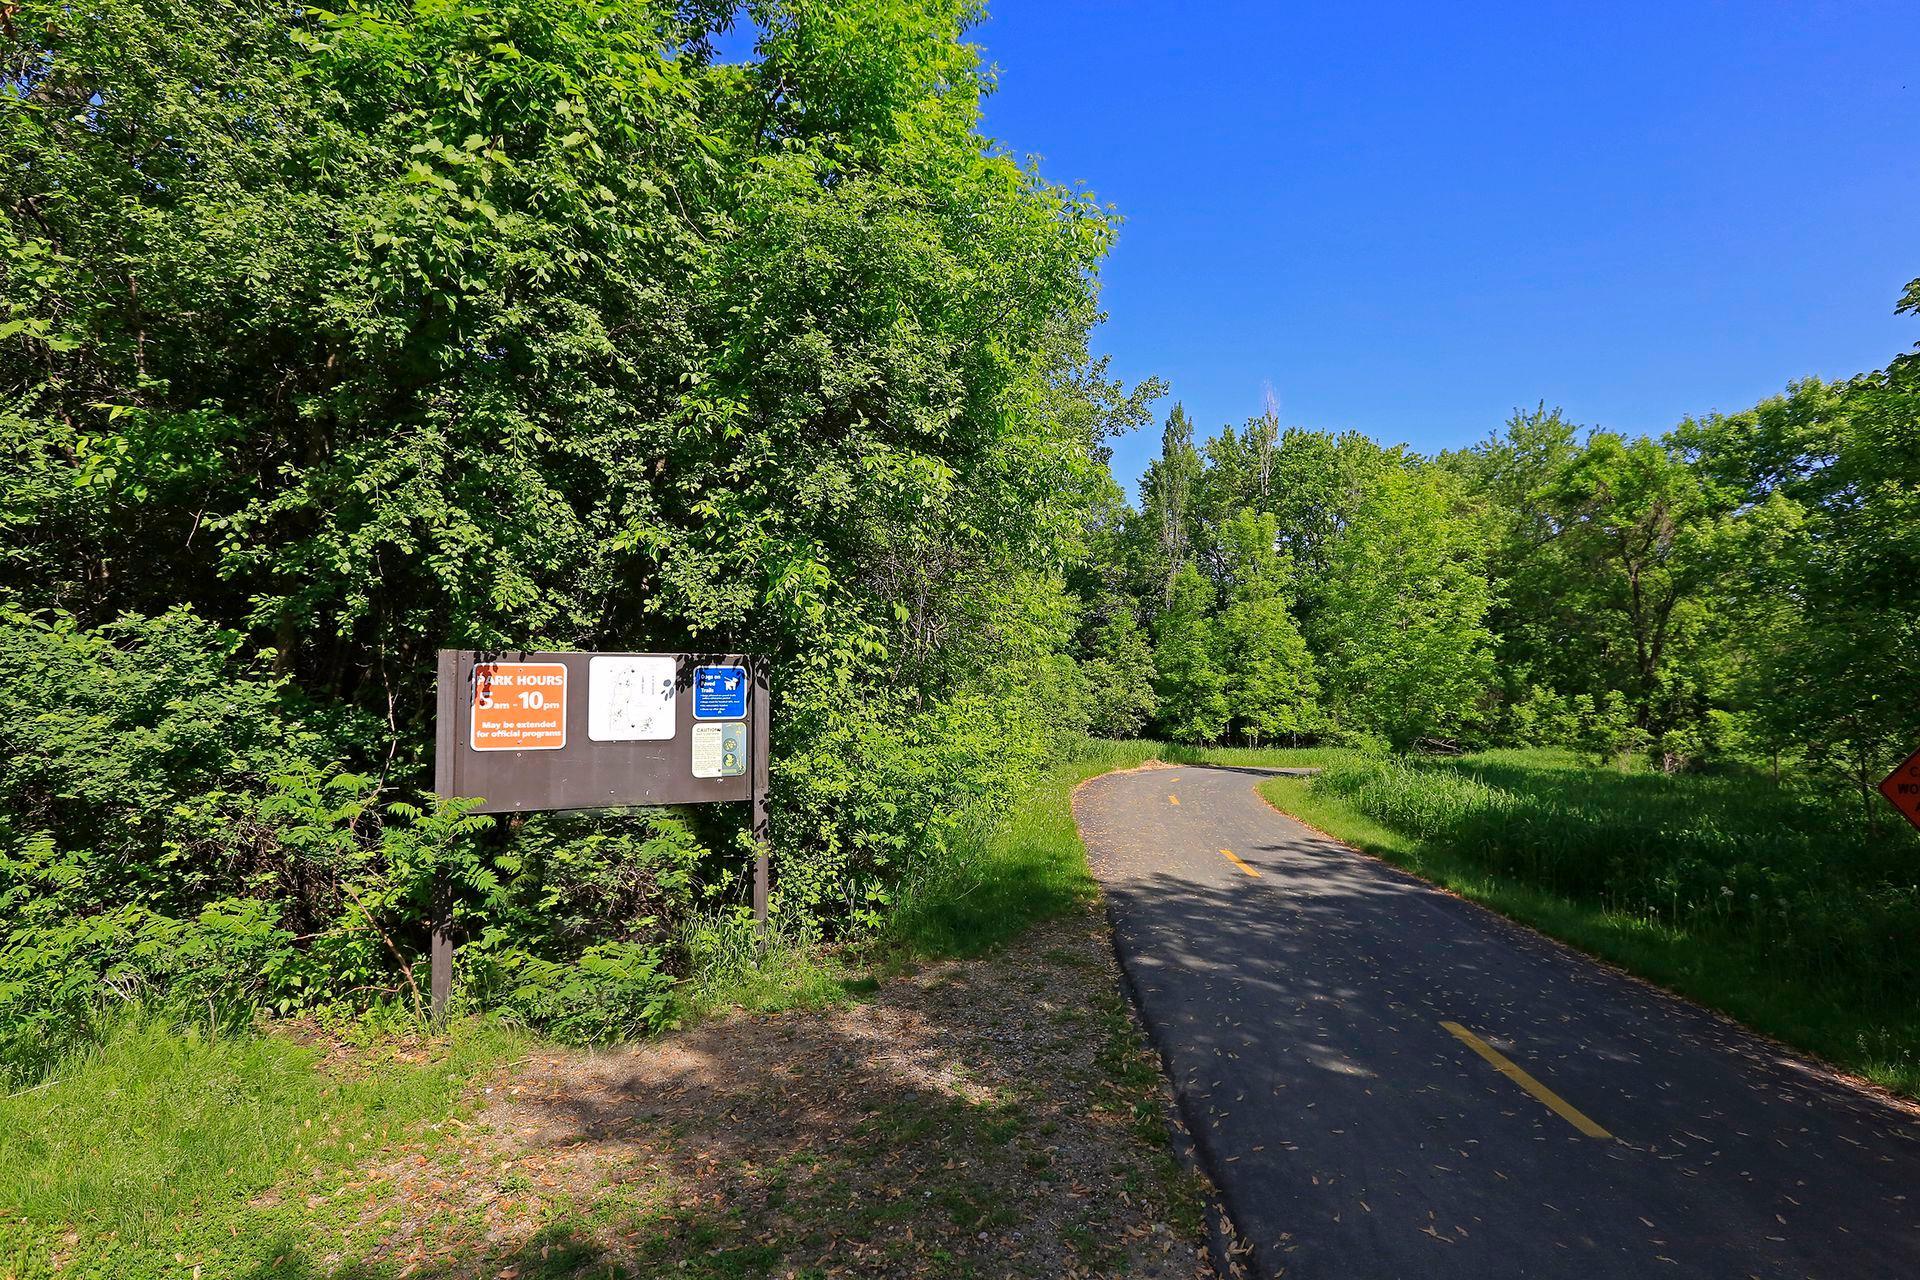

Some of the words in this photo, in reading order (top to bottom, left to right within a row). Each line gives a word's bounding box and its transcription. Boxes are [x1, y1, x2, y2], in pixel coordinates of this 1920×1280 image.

[477, 675, 513, 686] PARK
[516, 675, 562, 686] HOURS
[479, 691, 509, 709] 5am
[518, 691, 560, 710] 10pm
[482, 721, 501, 729] May
[516, 720, 556, 728] extended
[522, 730, 561, 738] programs
